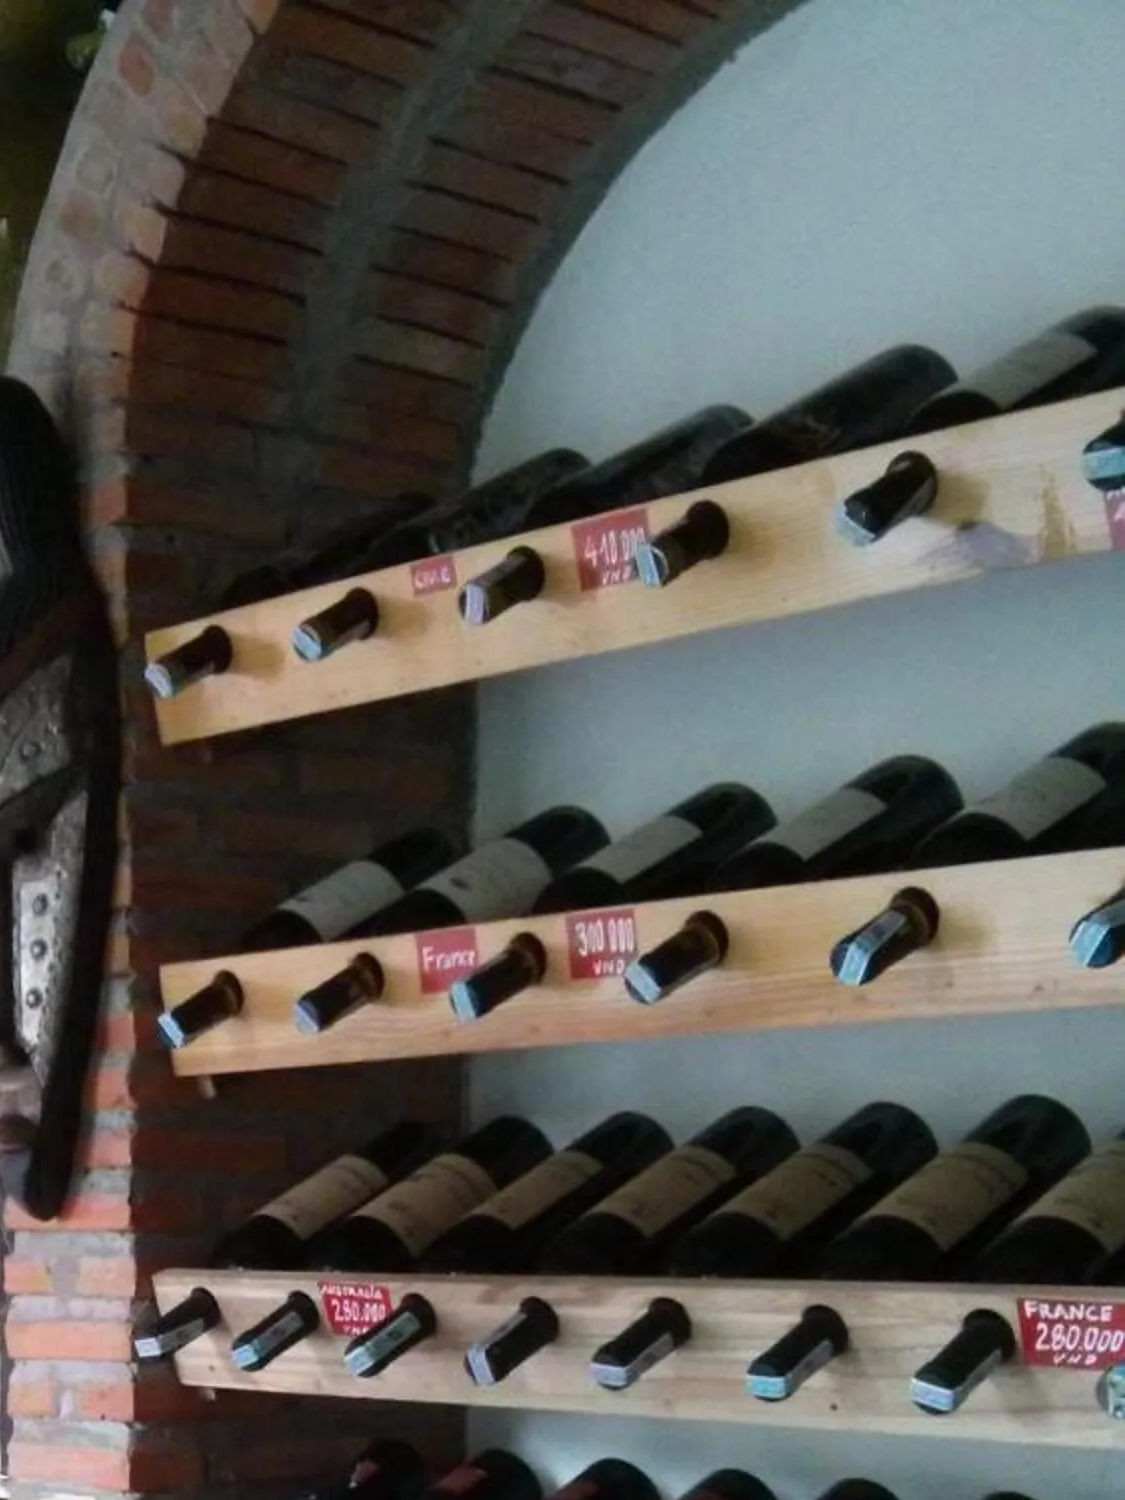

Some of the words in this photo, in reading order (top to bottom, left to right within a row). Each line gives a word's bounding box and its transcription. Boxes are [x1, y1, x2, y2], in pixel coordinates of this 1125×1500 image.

[1023, 1299, 1114, 1322] FRANCE
[1035, 1321, 1125, 1353] 280.000
[1052, 1352, 1098, 1366] VND
